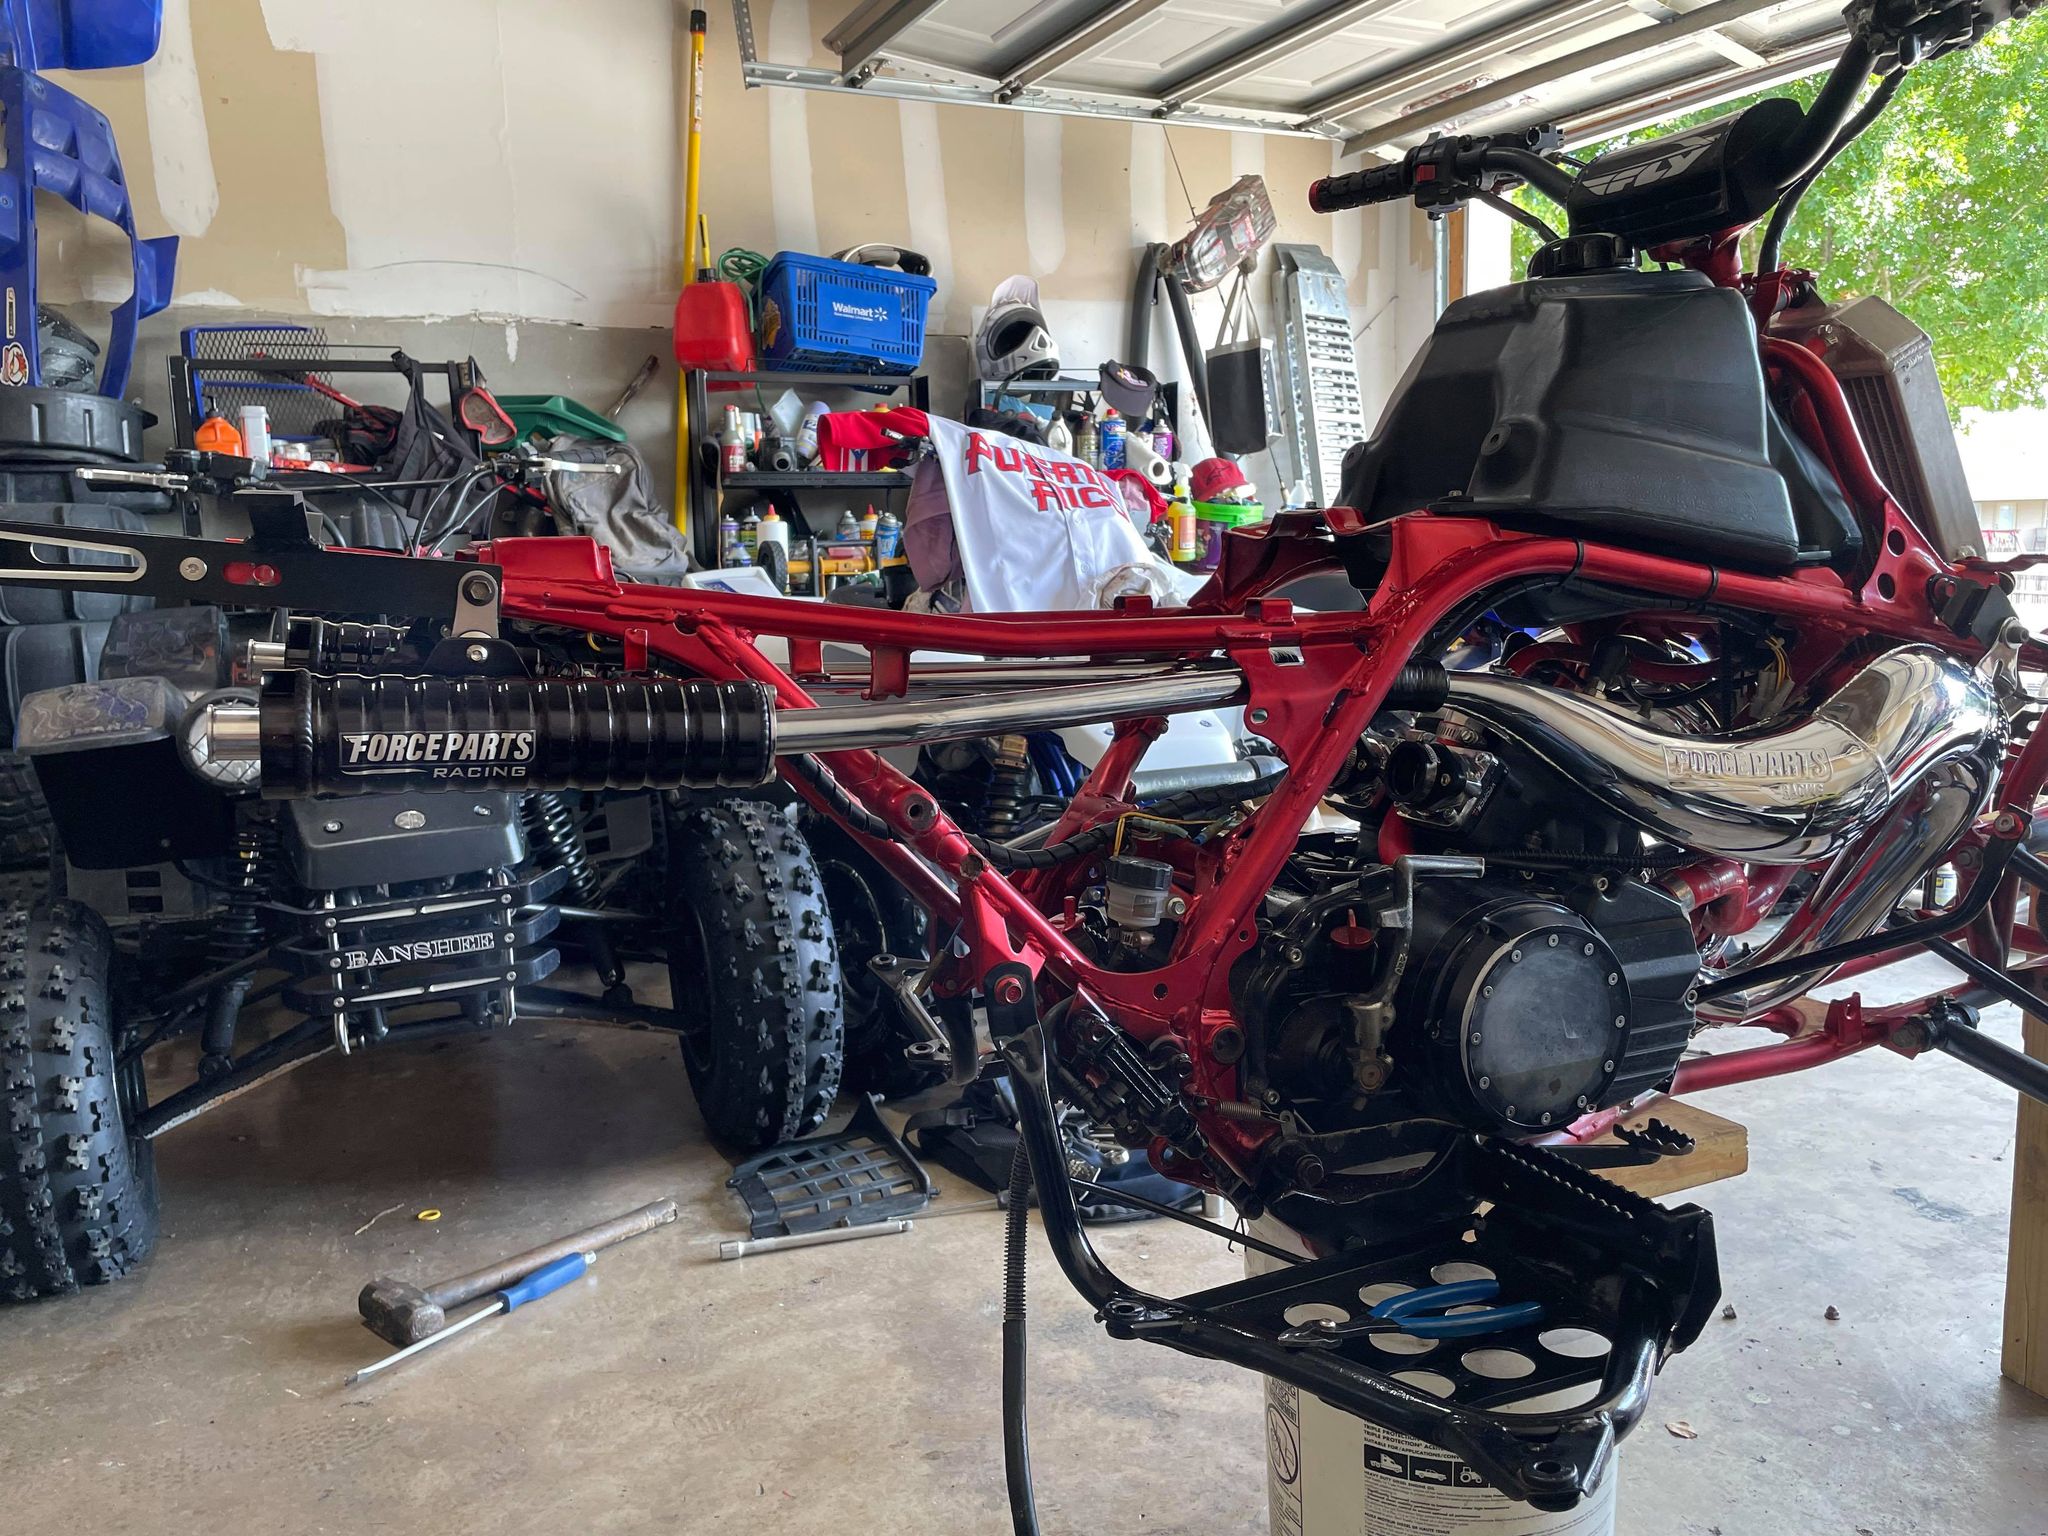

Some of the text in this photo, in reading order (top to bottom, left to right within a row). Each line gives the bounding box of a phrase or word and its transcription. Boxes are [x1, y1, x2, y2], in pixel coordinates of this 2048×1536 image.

[1582, 133, 1722, 197] FLY
[832, 301, 874, 318] Walmart
[965, 431, 1109, 492] PUERT
[1028, 478, 1124, 518] RIC
[433, 766, 527, 779] RACING
[345, 931, 495, 970] BANSHEE
[1364, 1430, 1380, 1439] TRIPLE
[1382, 1429, 1420, 1442] PROTECTIO
